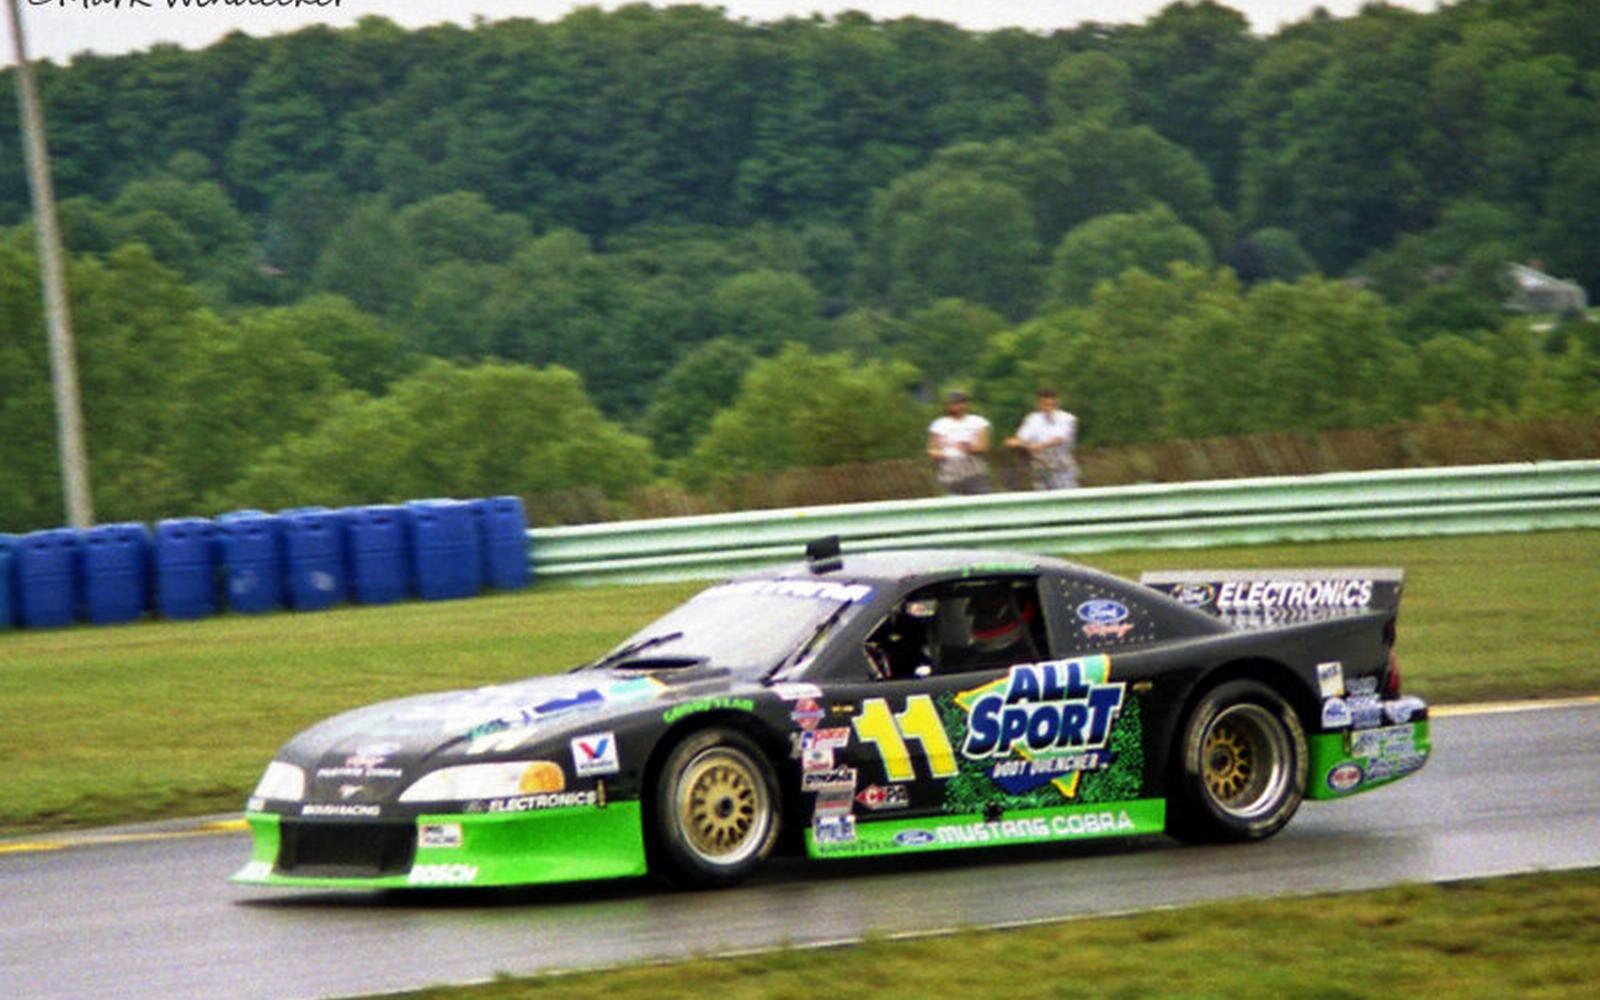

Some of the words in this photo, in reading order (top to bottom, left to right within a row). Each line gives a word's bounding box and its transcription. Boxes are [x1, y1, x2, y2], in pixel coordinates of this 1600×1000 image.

[1216, 581, 1372, 608] ELECTRONICS
[1003, 660, 1091, 705] ALL
[852, 694, 959, 781] 11
[962, 681, 1127, 759] SPORT
[488, 790, 597, 812] ELECTRONICS
[936, 818, 1051, 844] MUSTANG
[1052, 810, 1136, 835] COBRA
